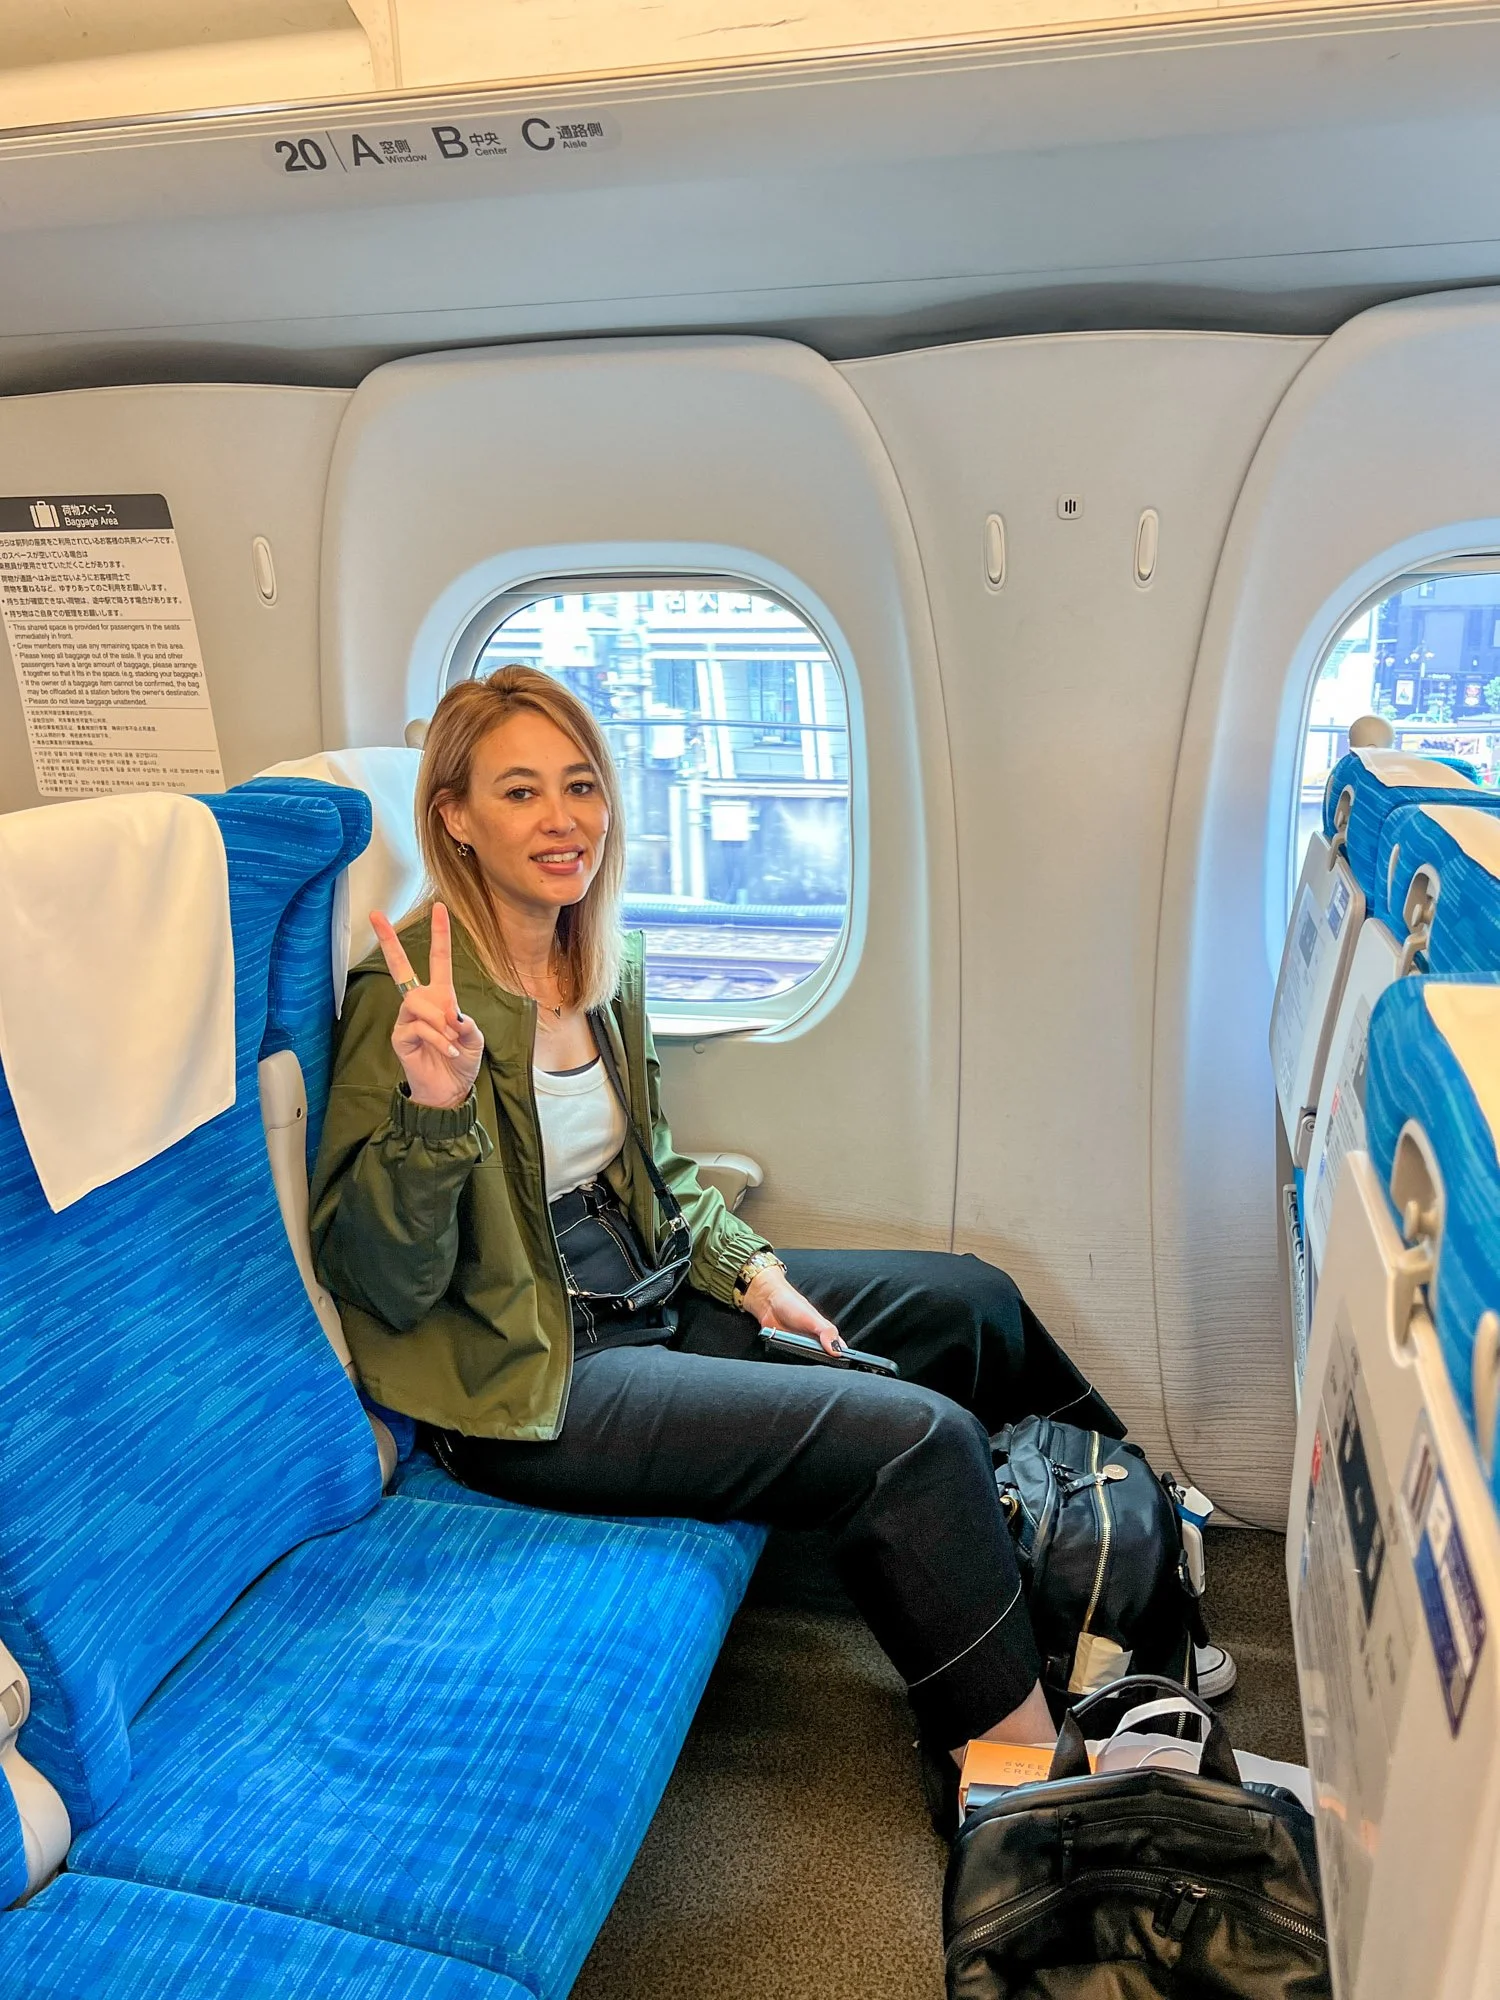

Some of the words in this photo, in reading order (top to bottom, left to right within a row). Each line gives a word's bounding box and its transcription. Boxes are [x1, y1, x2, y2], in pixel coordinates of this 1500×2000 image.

[521, 118, 555, 151] C
[556, 121, 603, 140] 通路側
[431, 126, 469, 159] B
[469, 132, 501, 147] 中央
[563, 139, 588, 150] Aisle
[274, 138, 327, 172] 20
[352, 134, 384, 166] A
[379, 139, 411, 155] 窓側
[474, 145, 508, 157] Center
[385, 152, 427, 165] Window
[61, 504, 116, 516] 荷物スペース
[65, 517, 99, 527] Baggage
[101, 516, 119, 526] Area
[74, 624, 100, 632] provided
[14, 632, 50, 641] immediately
[100, 643, 130, 651] remaining
[40, 652, 55, 660] keep
[64, 652, 90, 661] baggage
[77, 661, 92, 669] large
[152, 662, 172, 670] please
[27, 670, 50, 678] together
[134, 670, 158, 679] stacking
[72, 680, 98, 688] baggage
[144, 680, 175, 689] confirmed,
[187, 681, 200, 689] bag
[86, 698, 112, 706] baggage
[113, 698, 147, 706] unattended.
[1005, 1761, 1049, 1770] SWEE
